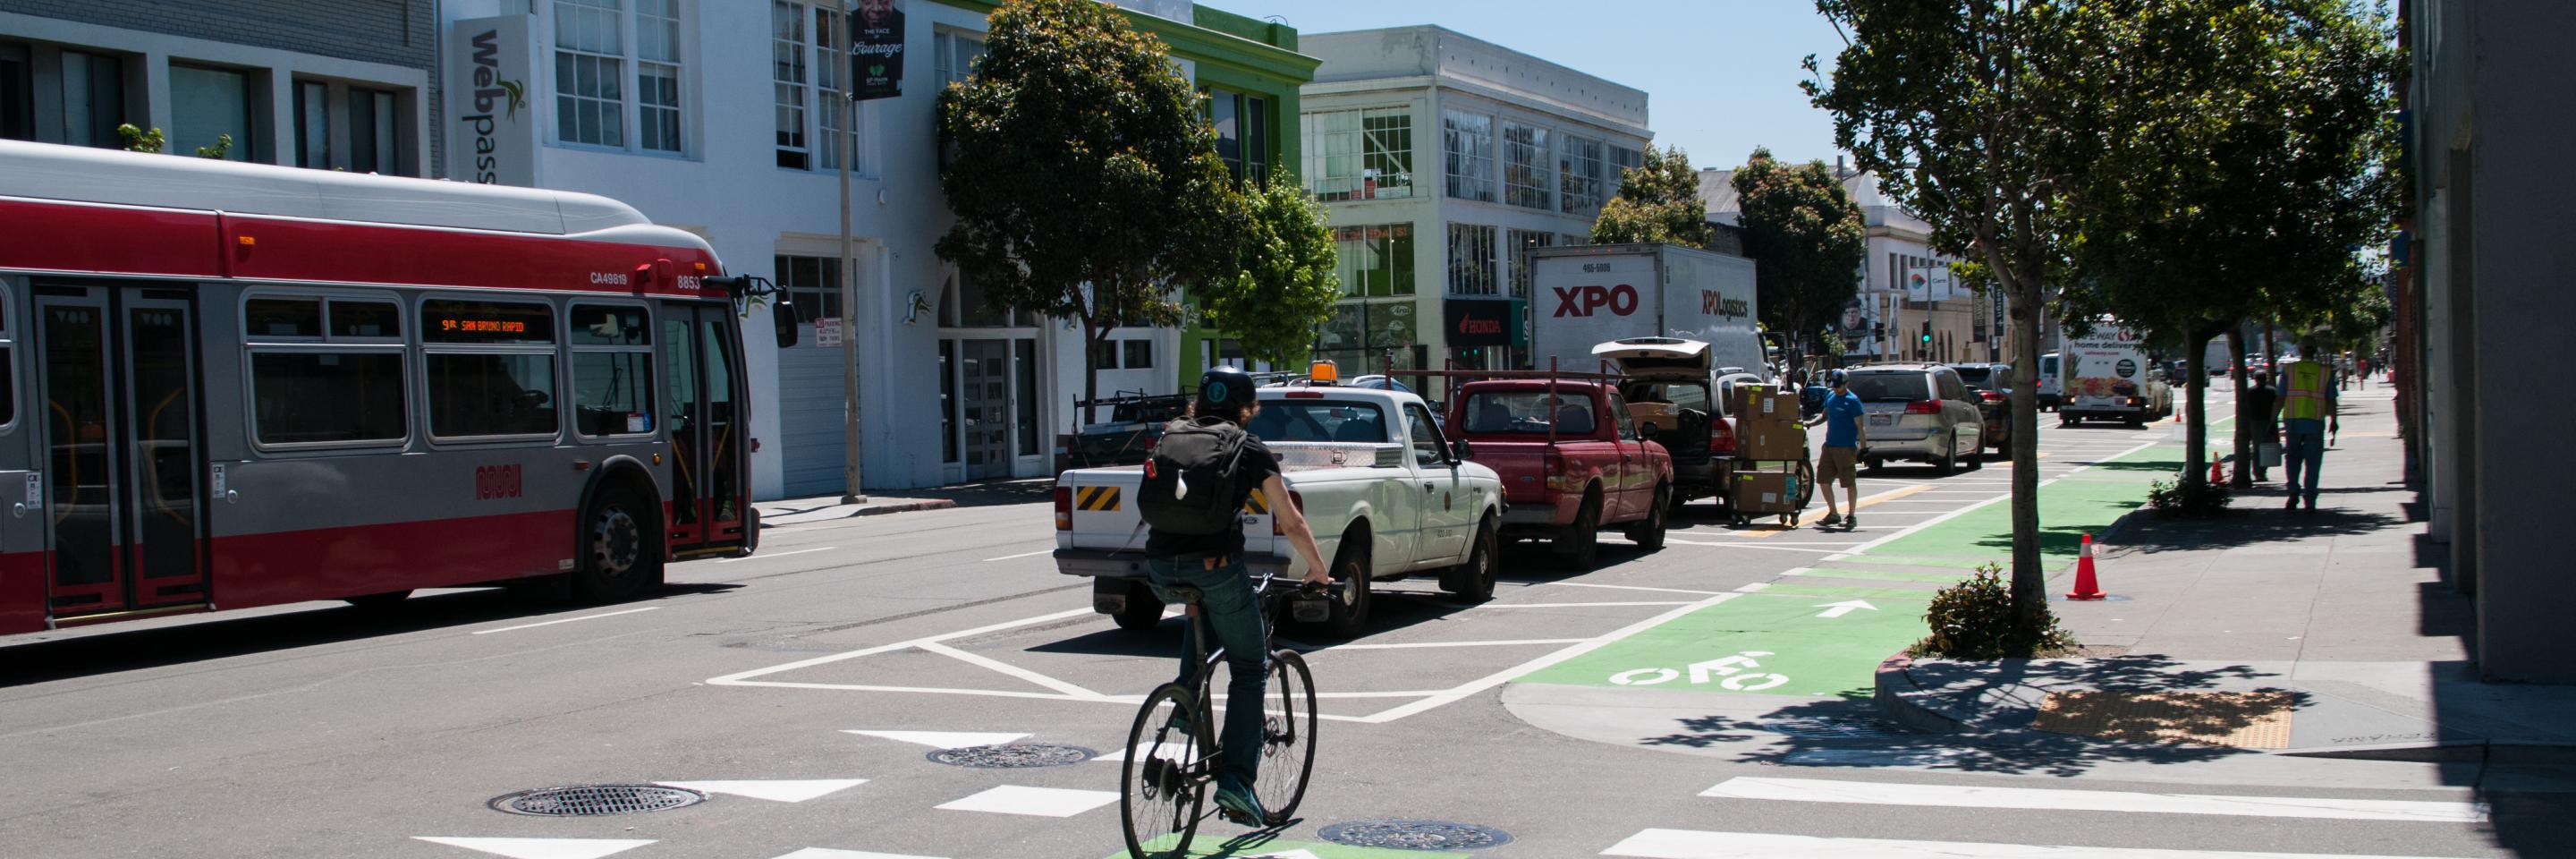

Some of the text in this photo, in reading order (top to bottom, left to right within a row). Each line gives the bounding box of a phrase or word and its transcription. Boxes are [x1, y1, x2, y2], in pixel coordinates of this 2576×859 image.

[852, 41, 902, 57] Courage
[677, 276, 700, 289] 8853
[1553, 284, 1639, 318] XPO
[1469, 319, 1501, 334] HONDA
[2074, 341, 2099, 349] home
